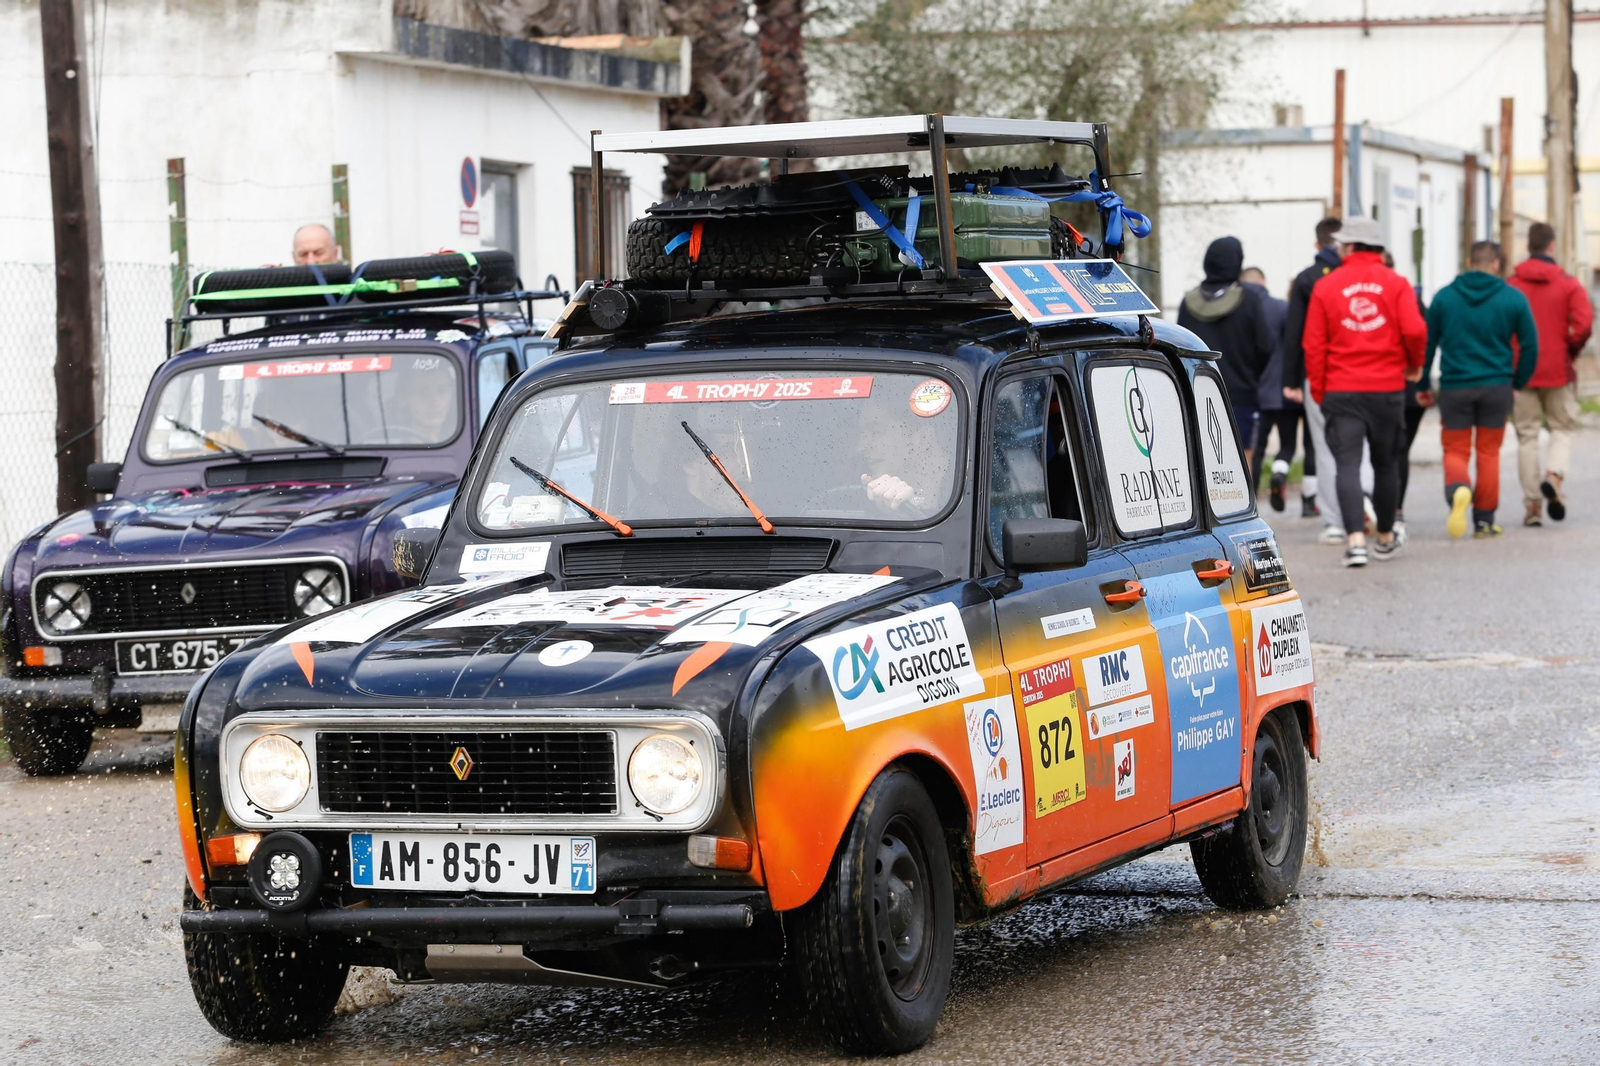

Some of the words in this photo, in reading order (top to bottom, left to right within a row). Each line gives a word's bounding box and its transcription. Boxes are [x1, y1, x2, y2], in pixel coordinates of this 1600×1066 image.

[276, 361, 325, 375] TROPHY
[666, 385, 688, 399] 4L
[696, 382, 770, 399] TROPHY
[773, 382, 813, 397] 2025
[922, 385, 942, 394] 872
[1211, 470, 1236, 486] RENAULT
[489, 553, 525, 561] FROID
[490, 546, 541, 554] MILLARD
[886, 616, 949, 652] CRÉDIT
[1272, 637, 1300, 660] DUPLEIX
[888, 643, 970, 687] AGRICOLE
[1020, 673, 1033, 692] 4L
[1033, 659, 1070, 688] TROPHY
[1099, 650, 1130, 687] RMC
[1171, 644, 1229, 684] capifrance
[916, 677, 960, 704] DIGOIN
[1038, 716, 1076, 769] 872
[1177, 726, 1213, 752] Philippe
[1215, 717, 1234, 741] GAY
[981, 787, 1020, 812] E.Leclerc
[359, 865, 366, 877] F
[573, 866, 593, 887] 71
